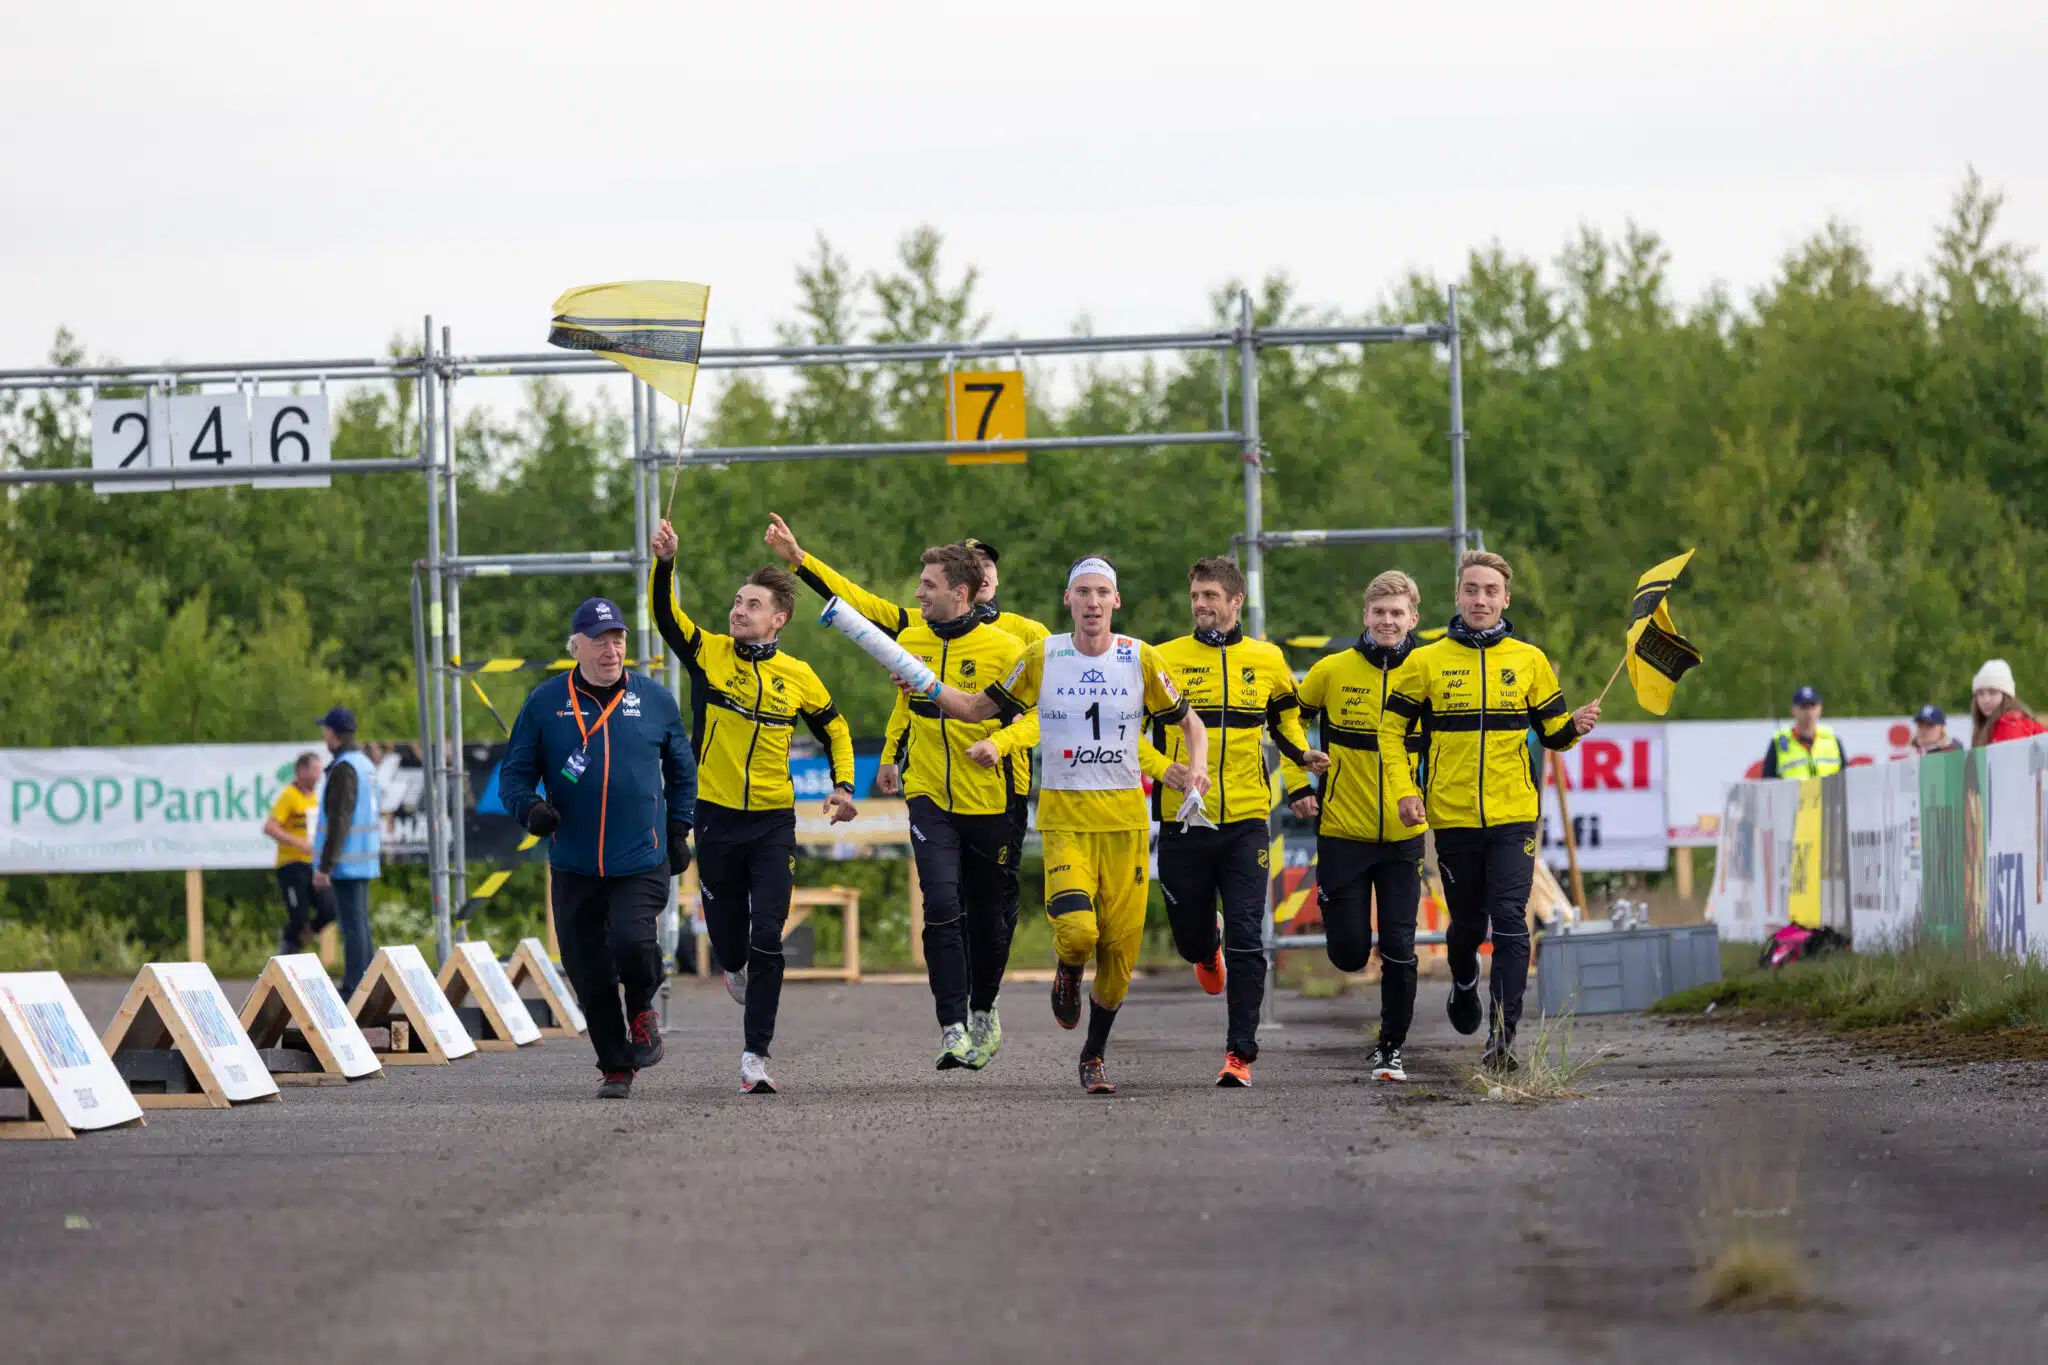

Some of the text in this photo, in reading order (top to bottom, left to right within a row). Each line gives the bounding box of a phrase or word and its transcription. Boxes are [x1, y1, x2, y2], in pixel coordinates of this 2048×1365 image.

[964, 383, 1004, 441] 7
[1057, 687, 1128, 696] KAUHAVA
[1341, 686, 1371, 694] TRIMTEX
[1084, 702, 1101, 741] 1
[1118, 724, 1126, 741] 7
[1070, 746, 1123, 768] jalas
[11, 772, 278, 825] POP Pankk
